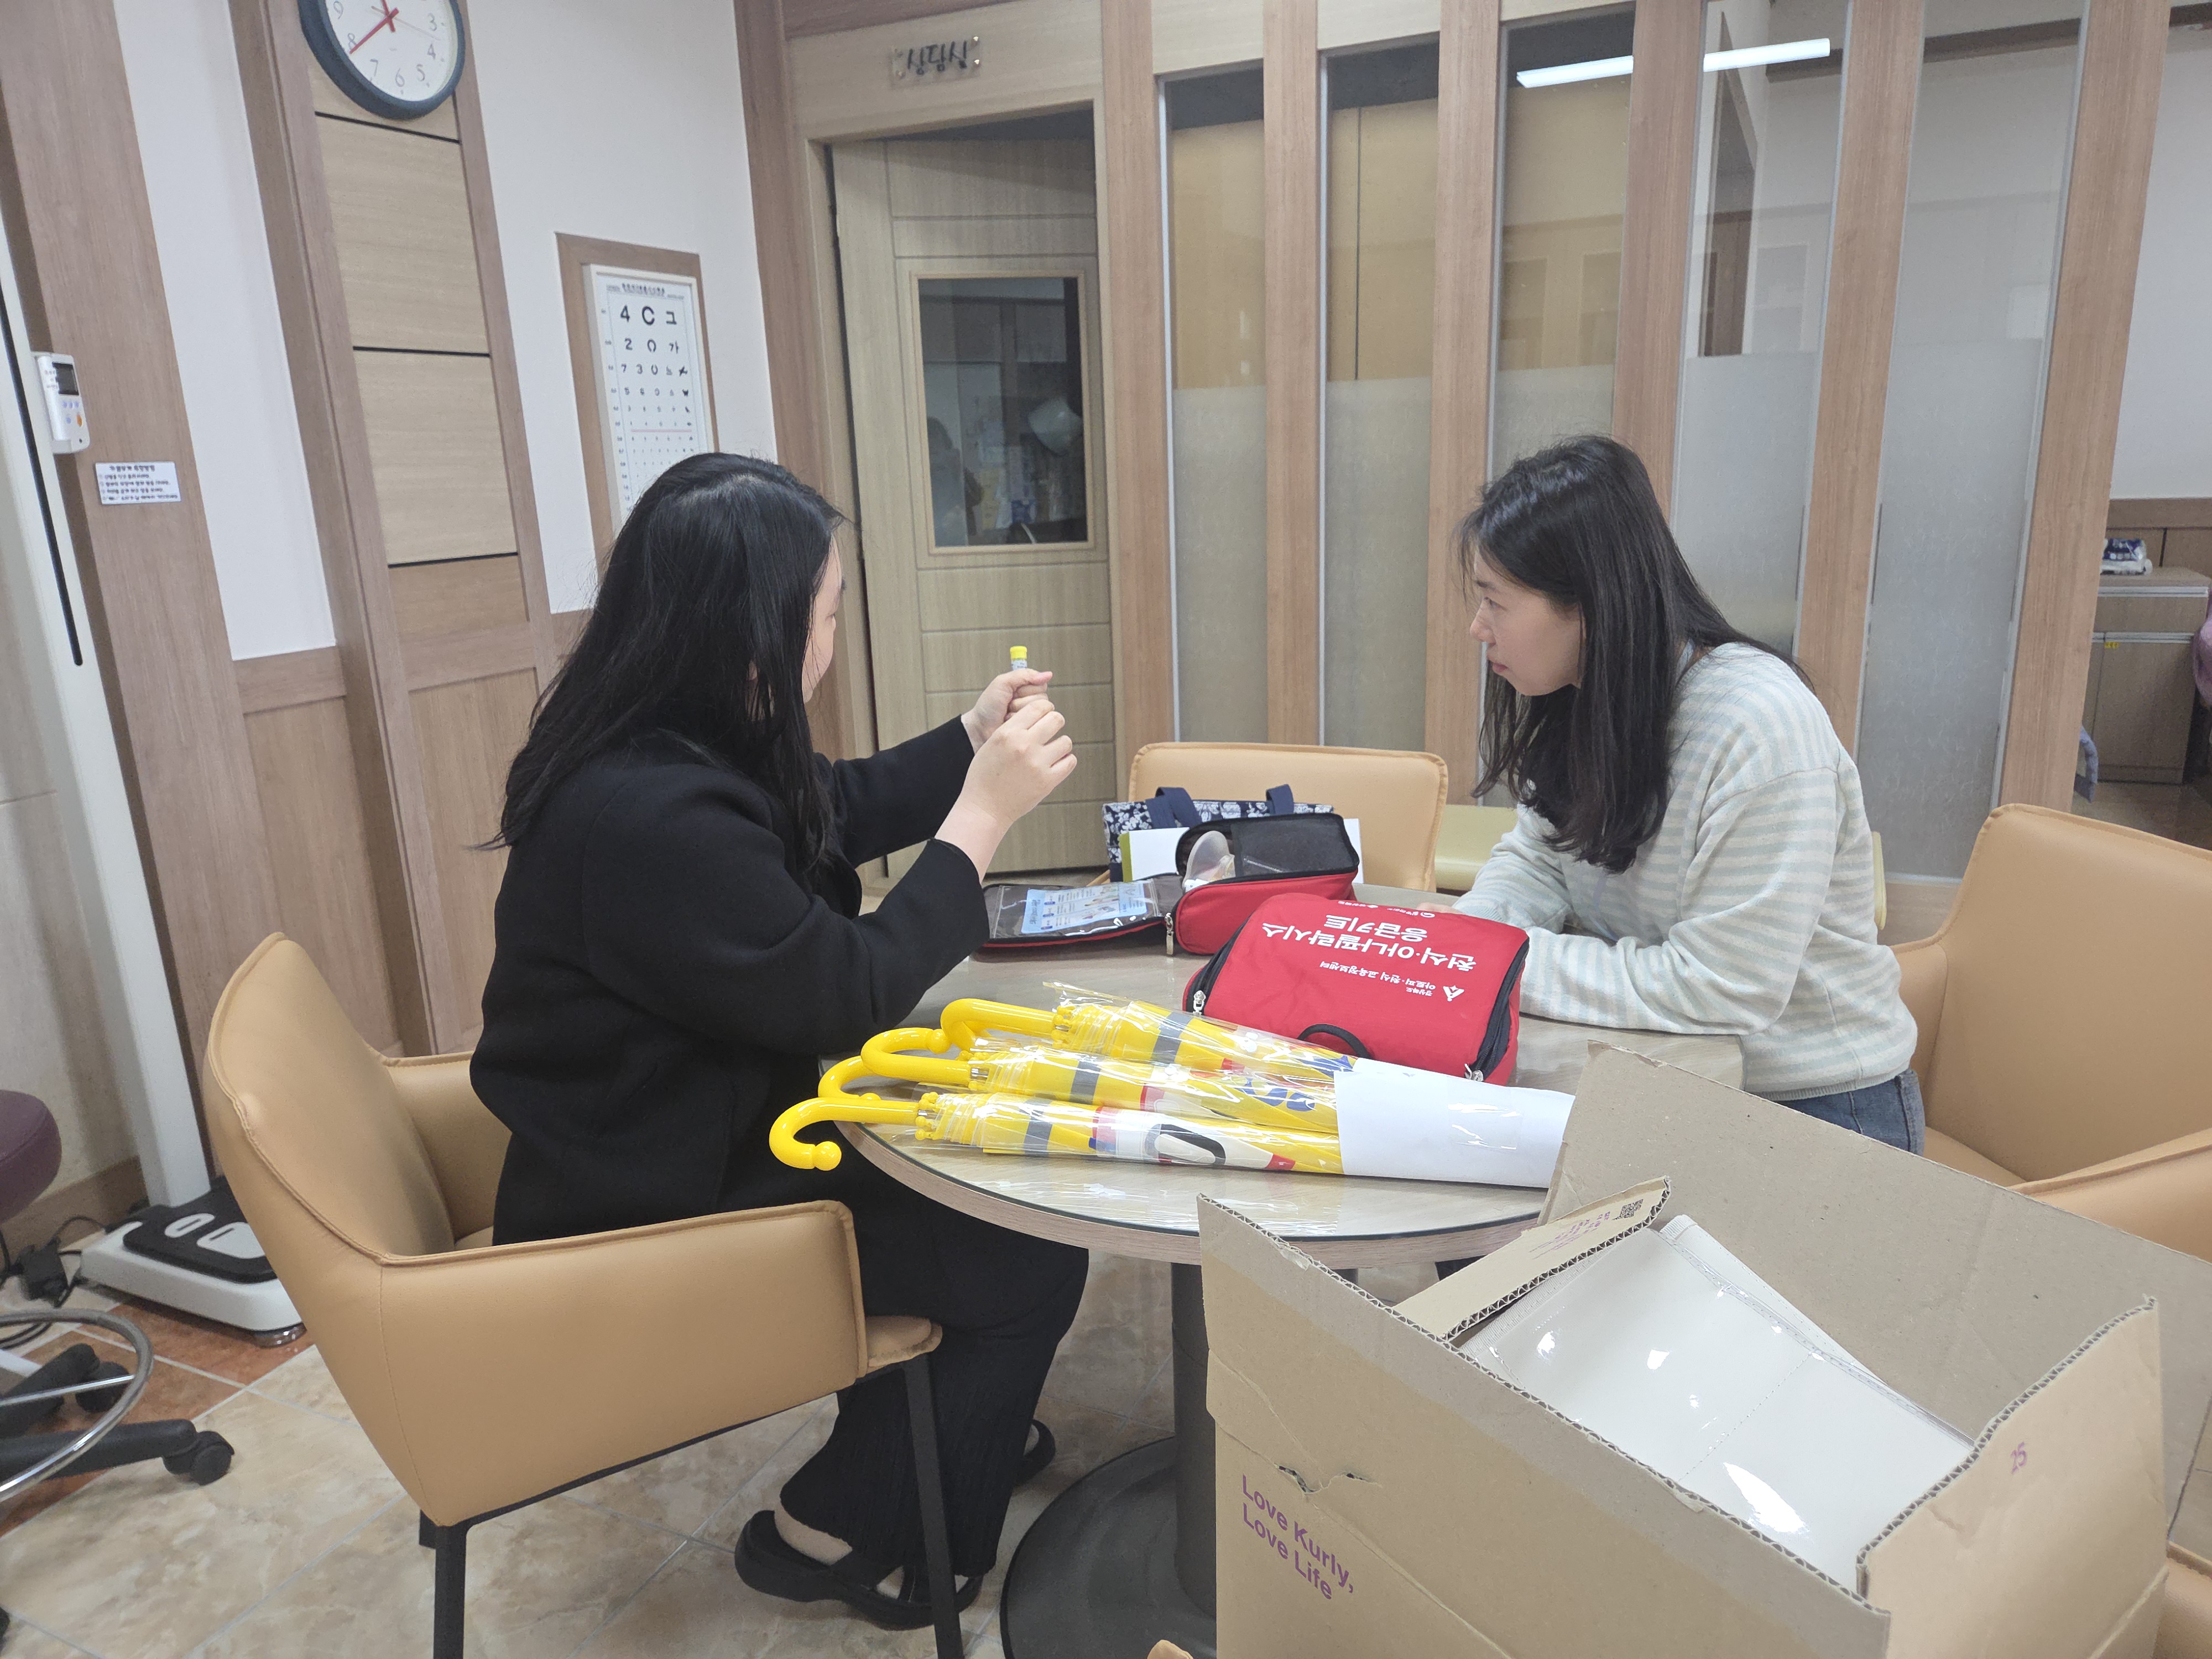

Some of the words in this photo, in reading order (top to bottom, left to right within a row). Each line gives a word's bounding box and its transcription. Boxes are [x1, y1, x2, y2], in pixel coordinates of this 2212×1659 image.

[333, 1, 344, 19] 9
[427, 13, 437, 32] 3
[347, 33, 356, 50] 8
[427, 43, 436, 59] 4
[369, 59, 379, 77] 7
[395, 67, 405, 87] 6
[416, 64, 426, 81] 5
[620, 305, 630, 322] 4
[624, 338, 633, 351] 2
[1324, 915, 1428, 942] 응급키트
[1262, 923, 1477, 972] 천식·아나필락시스
[1318, 961, 1379, 978] 교육정보센터
[1243, 1474, 1288, 1531] Love
[1294, 1521, 1354, 1593] Kurly,
[1243, 1502, 1288, 1559] Love
[1295, 1550, 1332, 1600] Life
